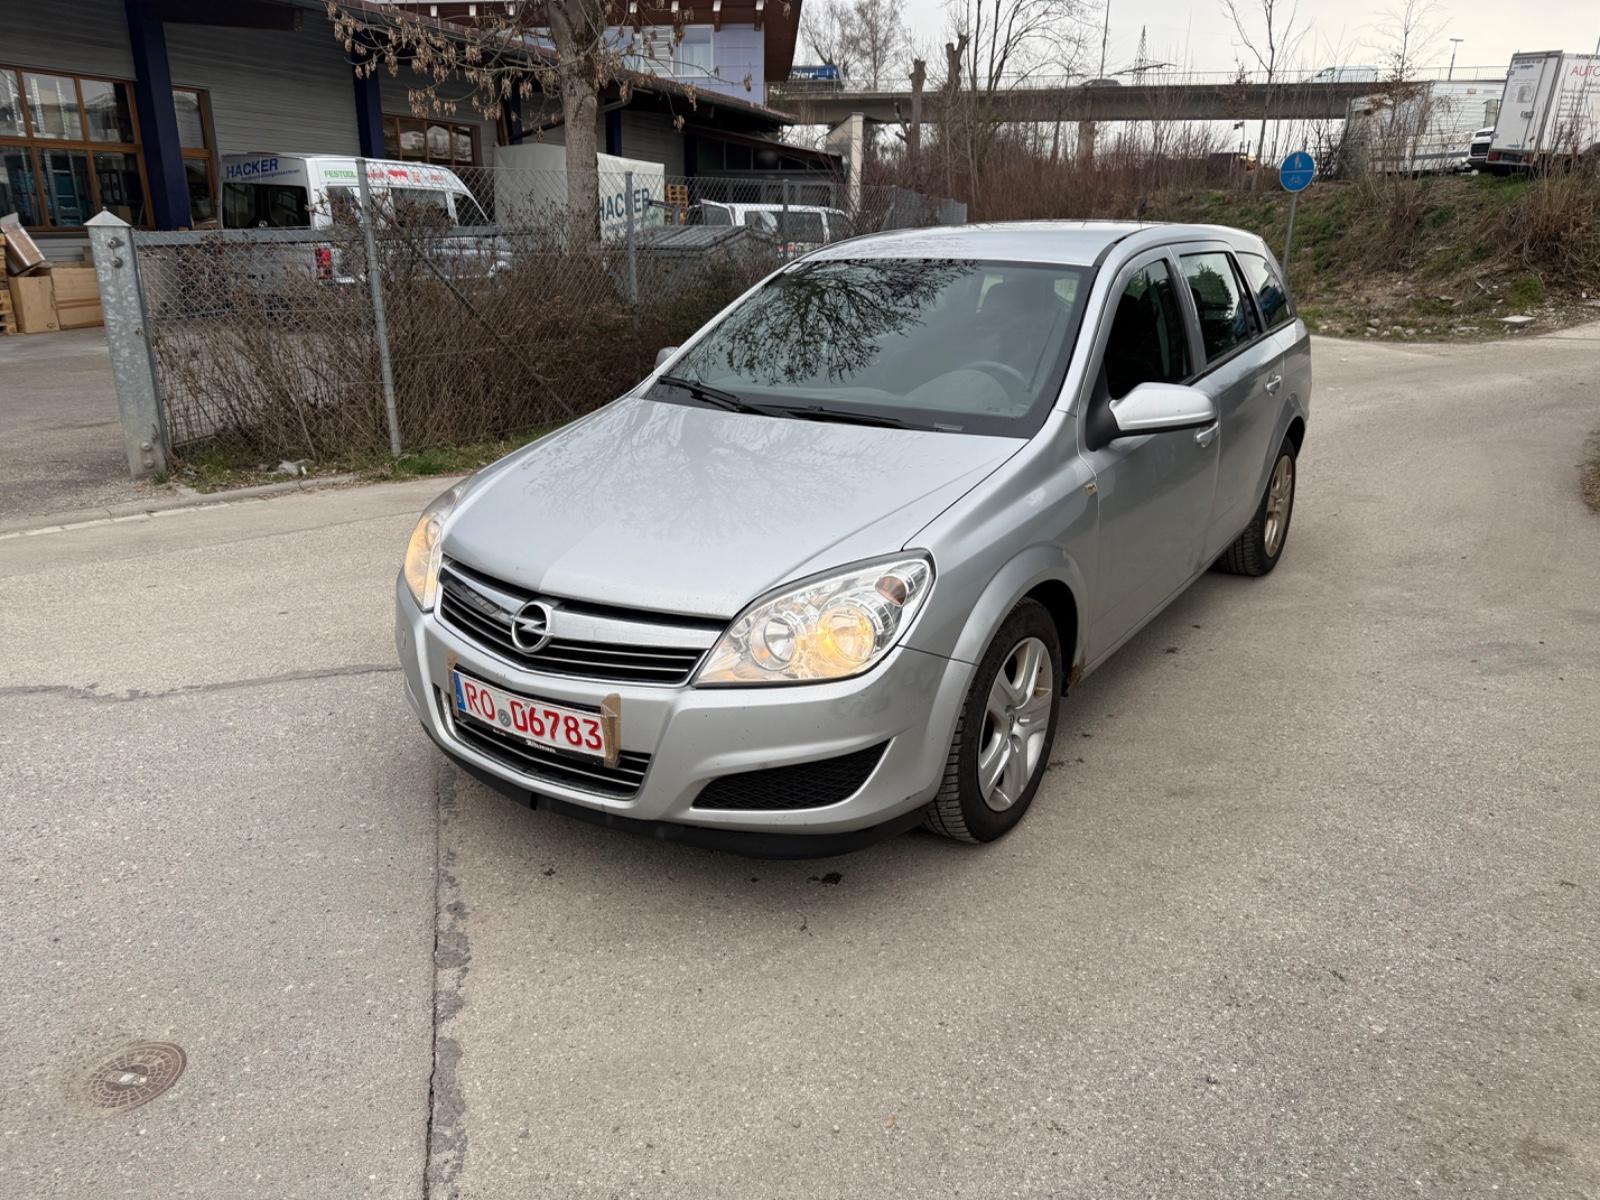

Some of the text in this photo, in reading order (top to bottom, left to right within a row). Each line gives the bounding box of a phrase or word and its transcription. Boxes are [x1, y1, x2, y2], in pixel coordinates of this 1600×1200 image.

[226, 158, 278, 178] HACKER
[324, 170, 358, 178] FESTOOL
[599, 188, 650, 221] HACER
[464, 682, 602, 750] RO 06783
